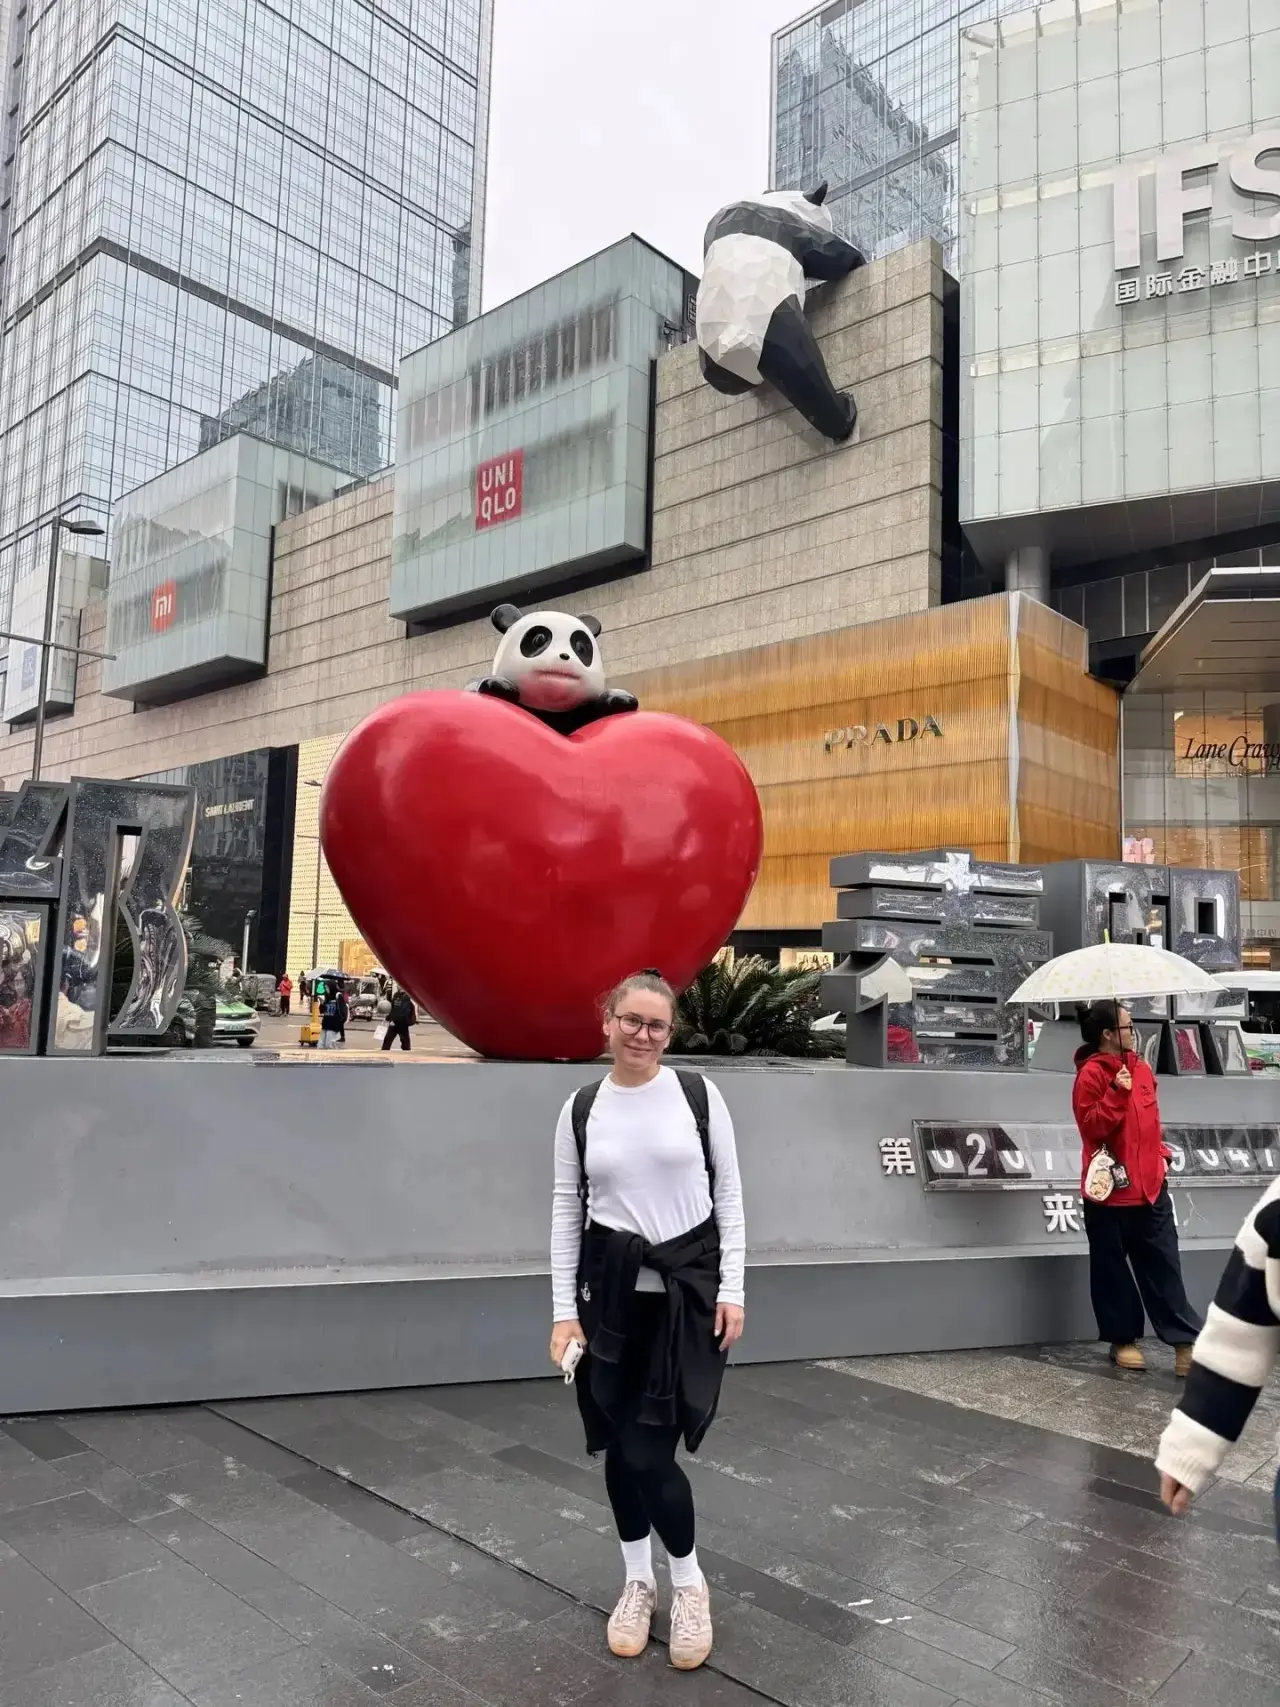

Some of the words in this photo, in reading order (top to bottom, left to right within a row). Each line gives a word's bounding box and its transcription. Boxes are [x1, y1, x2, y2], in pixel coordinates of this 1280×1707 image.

[1112, 129, 1280, 272] IFS
[1115, 249, 1280, 306] 国际金融中
[482, 459, 514, 492] UNI
[481, 487, 516, 521] QLO
[823, 713, 944, 754] PRADA
[1182, 738, 1227, 759] Lane
[878, 1136, 916, 1177] 第
[1042, 1192, 1085, 1233] 来
